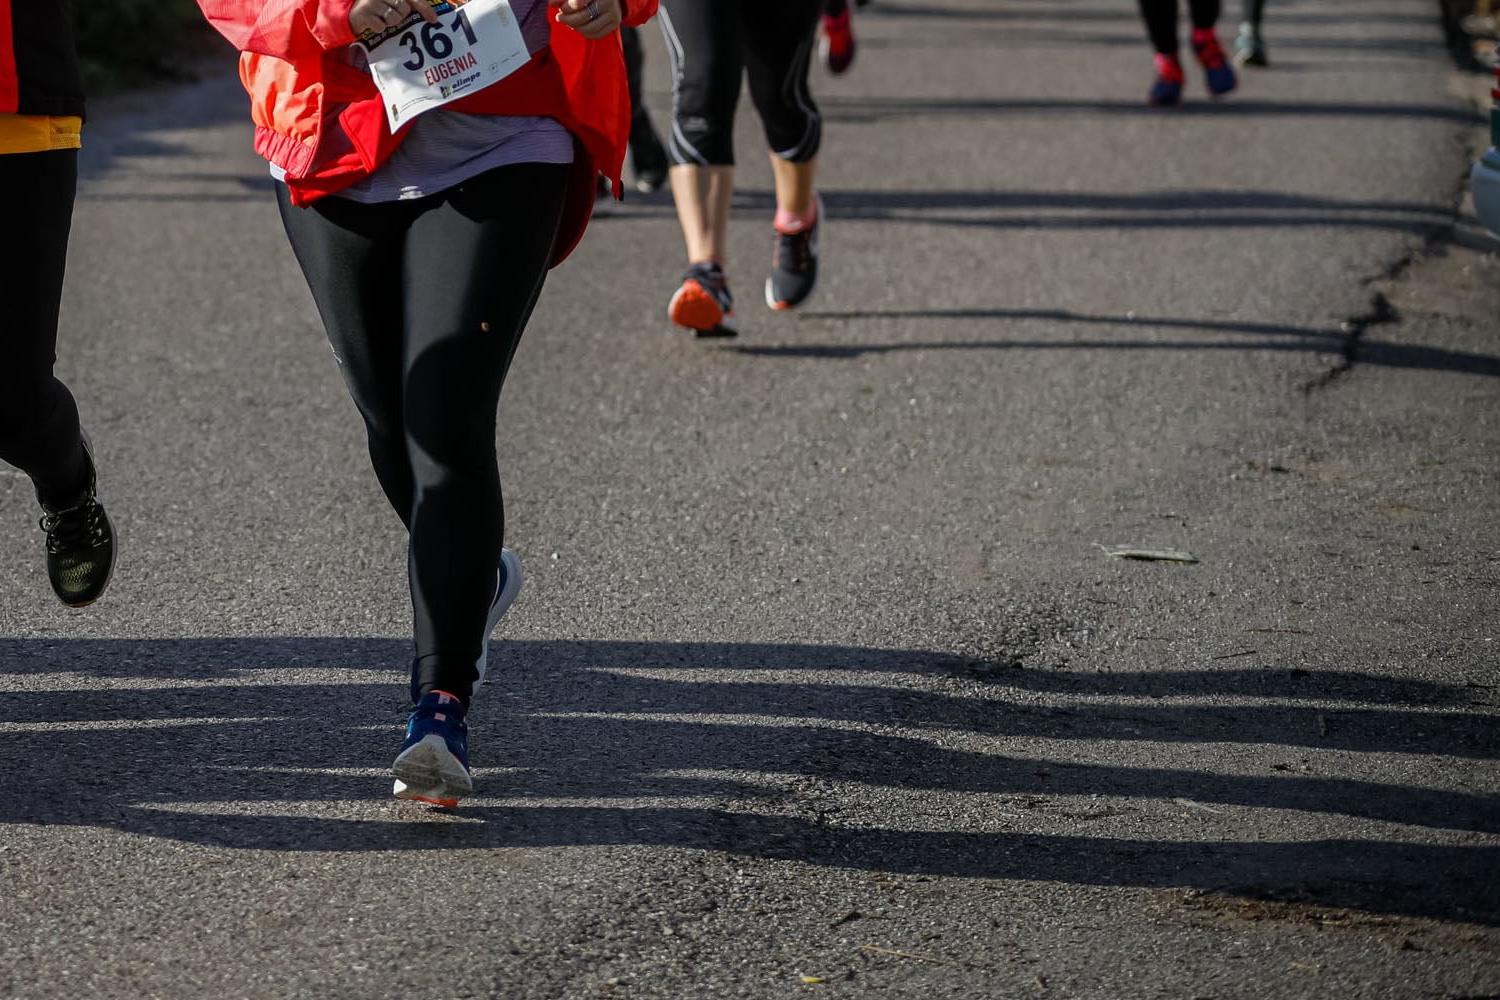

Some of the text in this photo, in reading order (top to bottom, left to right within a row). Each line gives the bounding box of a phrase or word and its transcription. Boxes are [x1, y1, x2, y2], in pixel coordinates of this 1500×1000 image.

[399, 9, 478, 71] 361
[424, 52, 478, 87] EUGENIA
[452, 71, 481, 90] olimpo
